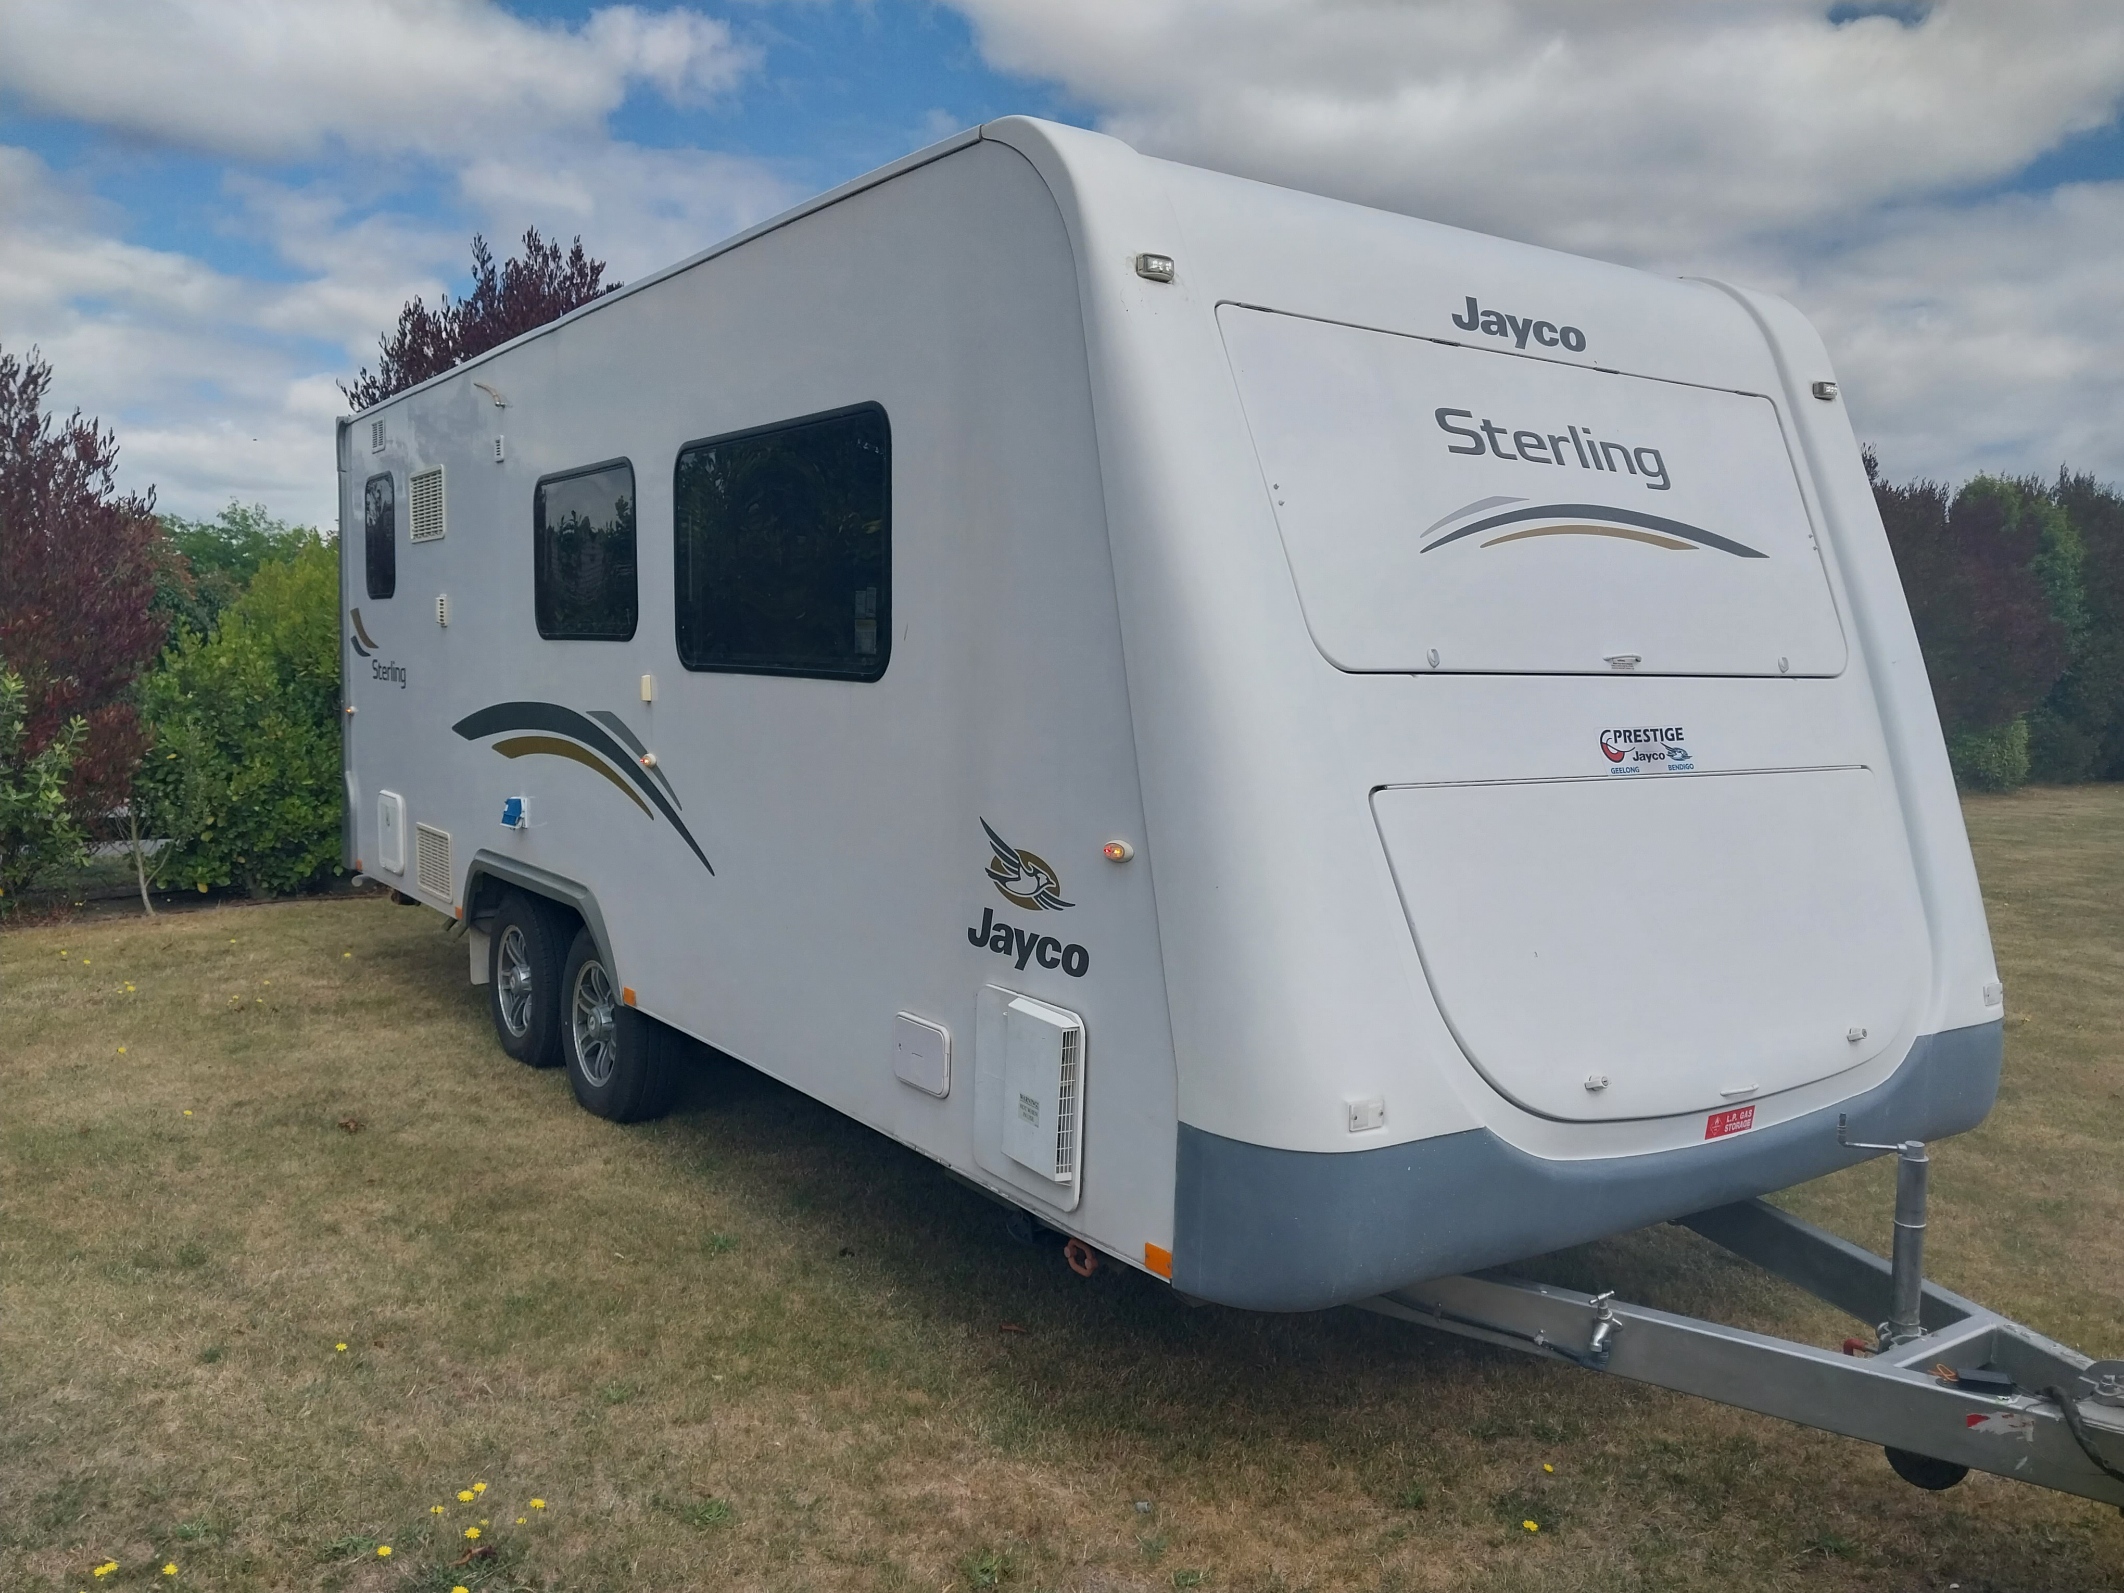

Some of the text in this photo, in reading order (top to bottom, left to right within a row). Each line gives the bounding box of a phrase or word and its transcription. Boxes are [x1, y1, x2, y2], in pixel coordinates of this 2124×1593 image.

[1451, 295, 1587, 353] Jayco
[1433, 407, 1672, 491] Sterling
[371, 658, 407, 690] Sterling
[1612, 727, 1685, 744] PRESTIGE
[1632, 750, 1666, 763] Jayco
[1610, 763, 1695, 775] GEELONG BENDIGO
[967, 907, 1090, 978] Jayco
[1739, 1109, 1753, 1120] GAS
[1724, 1119, 1752, 1133] STORAGE
